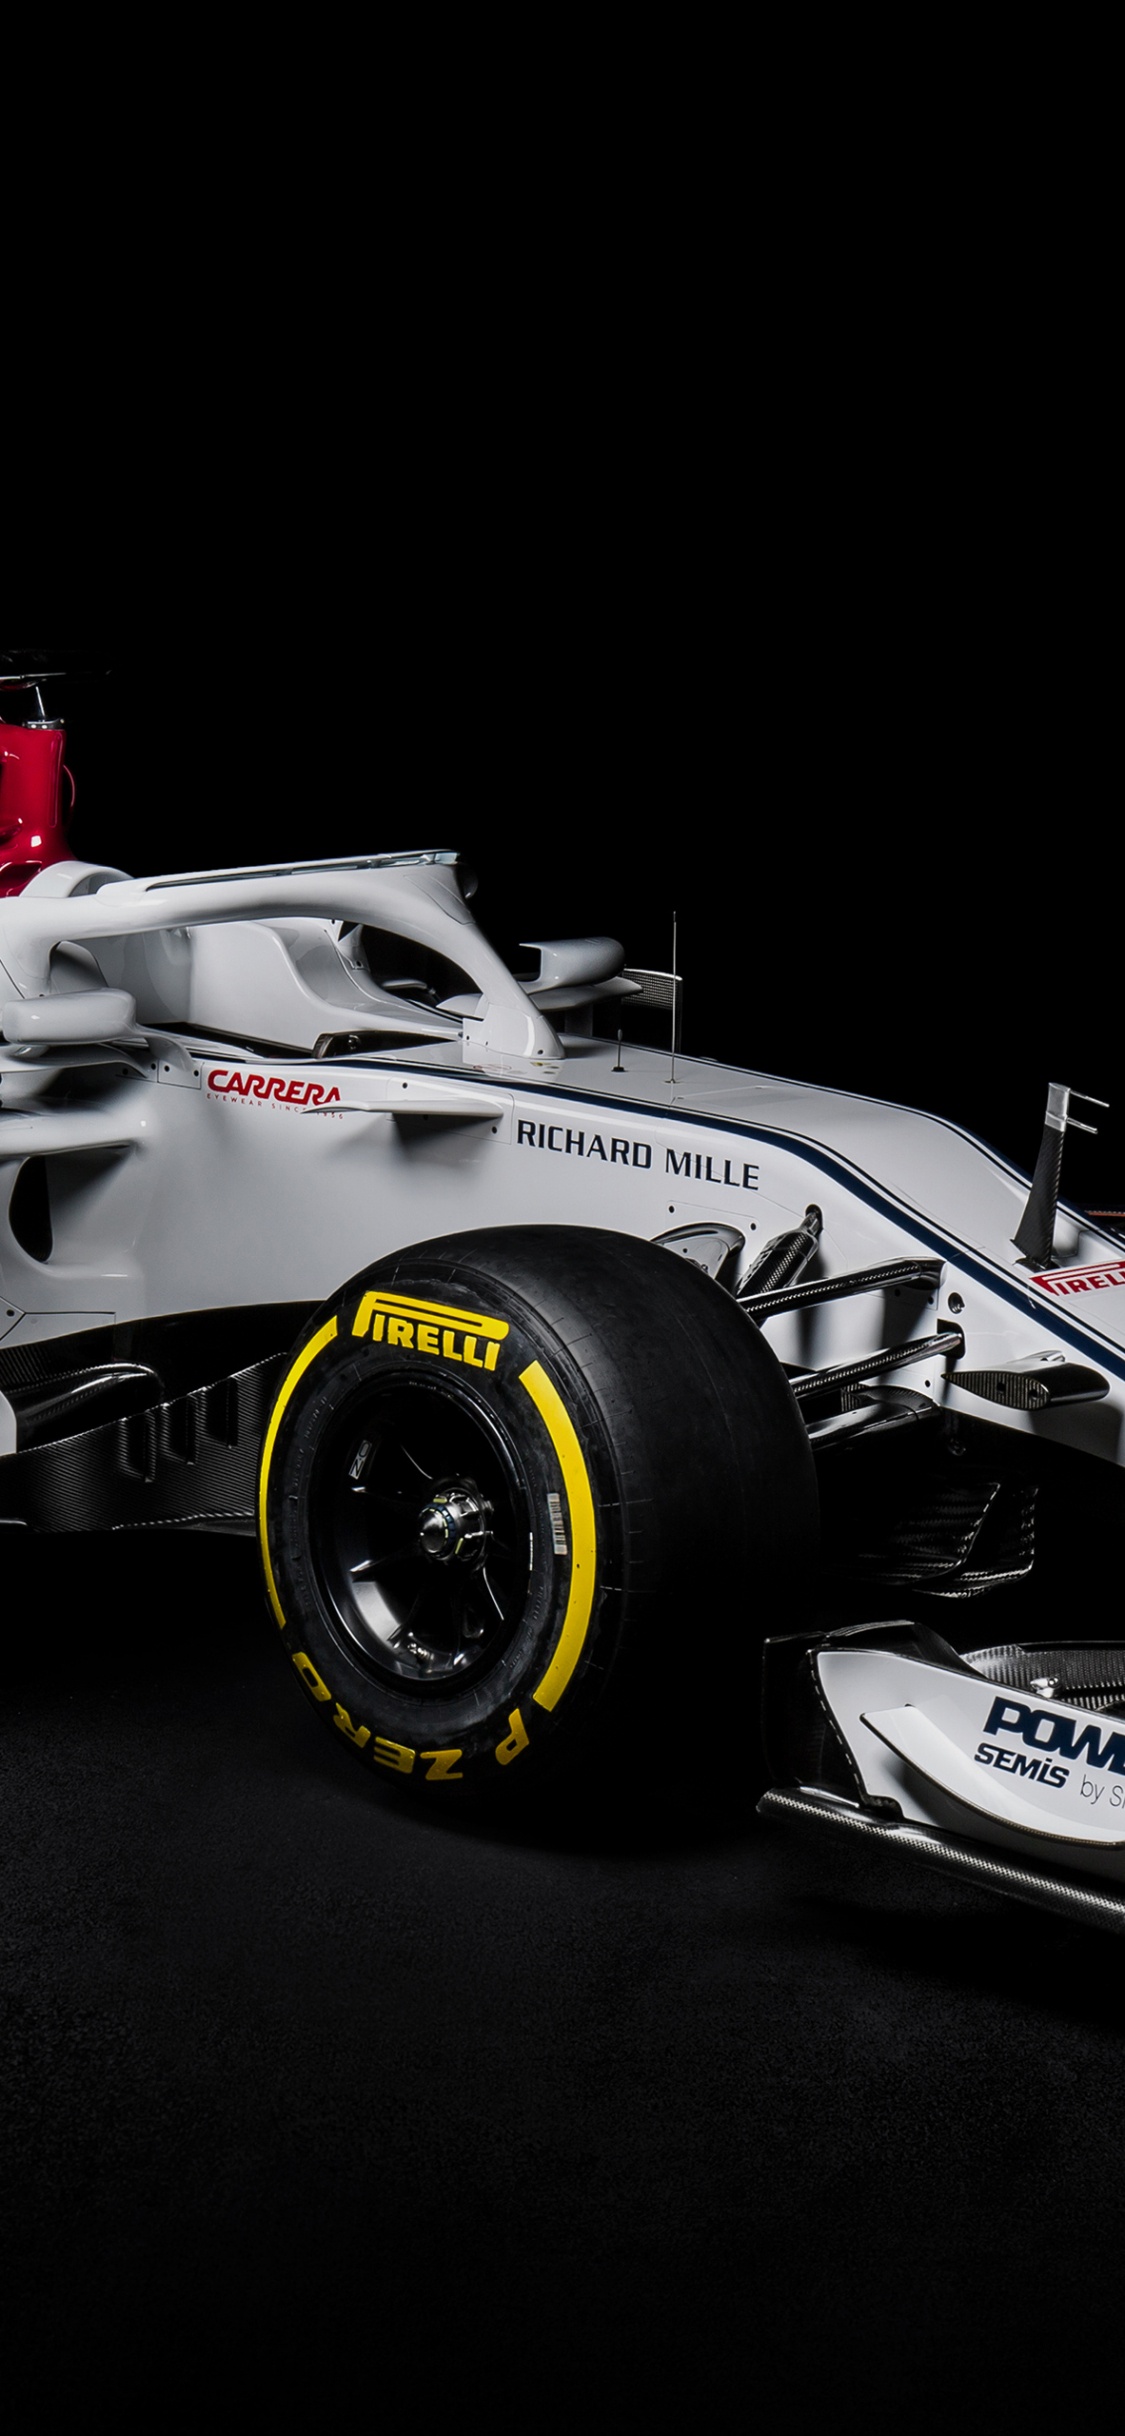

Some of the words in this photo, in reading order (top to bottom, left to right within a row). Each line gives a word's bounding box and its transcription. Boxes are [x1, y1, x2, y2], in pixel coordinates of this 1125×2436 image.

[206, 1093, 262, 1107] EYEWEAR
[208, 1069, 341, 1106] CARRERA
[517, 1119, 652, 1169] RICHARD
[665, 1148, 760, 1190] MILLE
[352, 1290, 509, 1371] PIRELLI
[291, 1651, 463, 1780] ZERO
[495, 1707, 530, 1765] P
[1080, 1774, 1105, 1804] by
[1109, 1785, 1125, 1808] S
